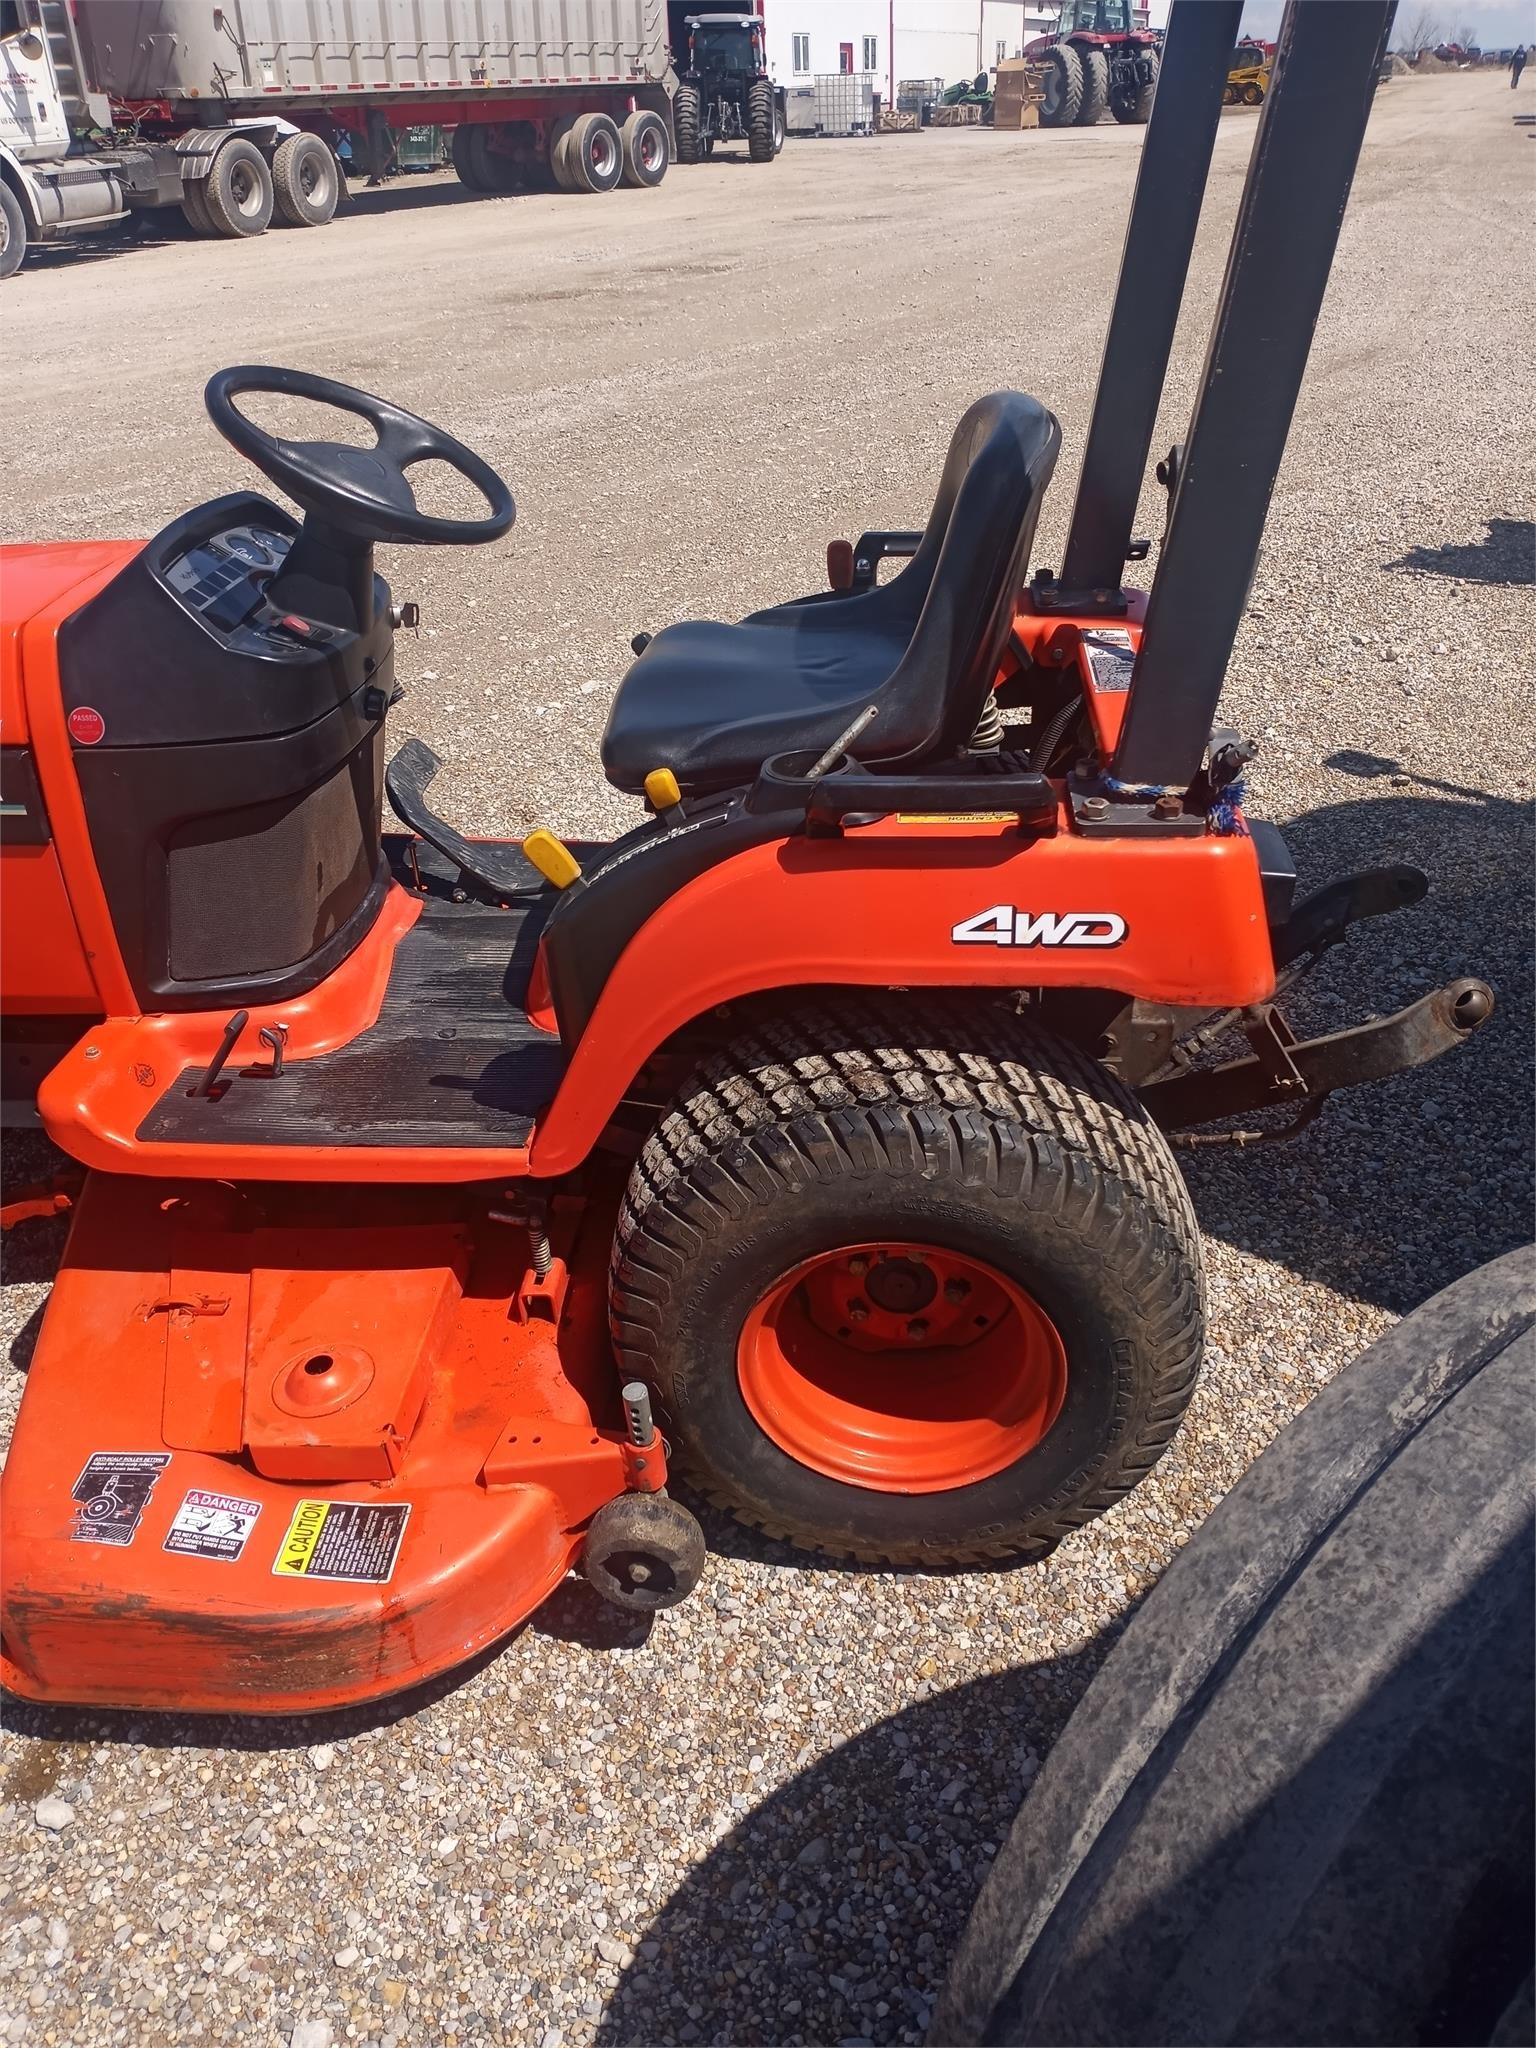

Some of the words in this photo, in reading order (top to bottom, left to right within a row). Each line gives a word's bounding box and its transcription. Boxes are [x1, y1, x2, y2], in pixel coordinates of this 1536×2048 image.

[72, 714, 98, 722] PASSED
[952, 904, 1127, 945] 4WD
[199, 1495, 259, 1515] DANGER
[289, 1503, 324, 1553] CAUTION
[326, 1543, 335, 1554] STOP
[309, 1557, 318, 1569] KEEP
[314, 1558, 323, 1569] STOP
[332, 1560, 341, 1571] KEEP
[367, 1563, 376, 1574] STOP
